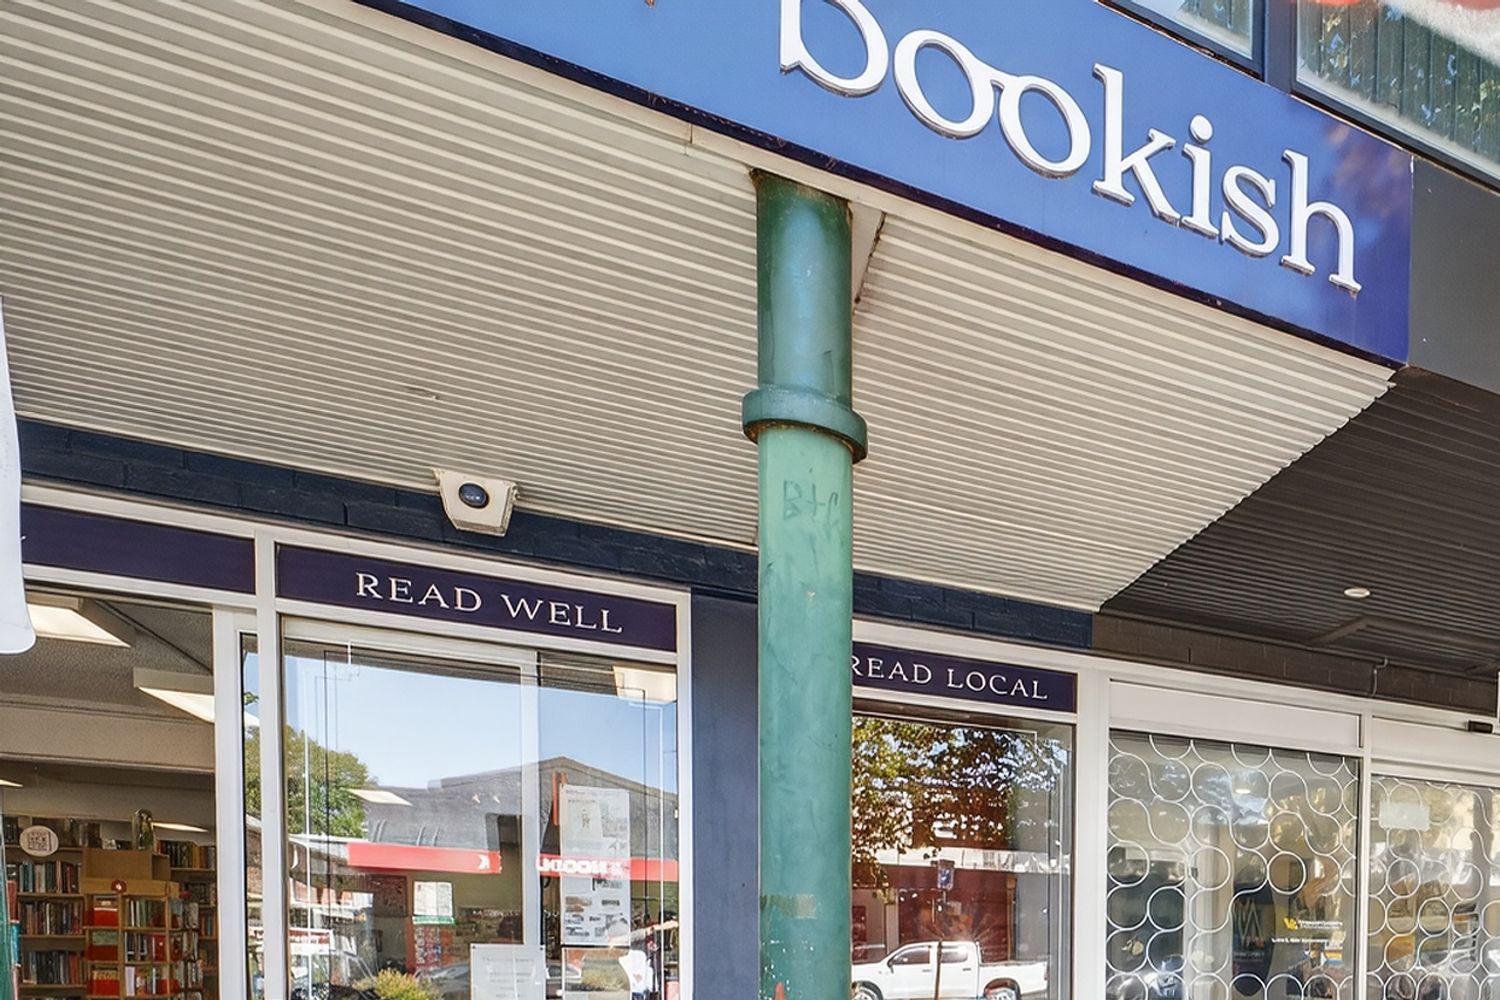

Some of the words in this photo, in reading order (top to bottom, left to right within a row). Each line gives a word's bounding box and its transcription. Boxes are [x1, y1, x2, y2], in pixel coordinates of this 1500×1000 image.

[779, 0, 1362, 292] bookish
[355, 572, 482, 613] READ
[501, 594, 623, 634] WELL
[851, 655, 932, 685] READ
[946, 668, 1048, 700] LOCAL
